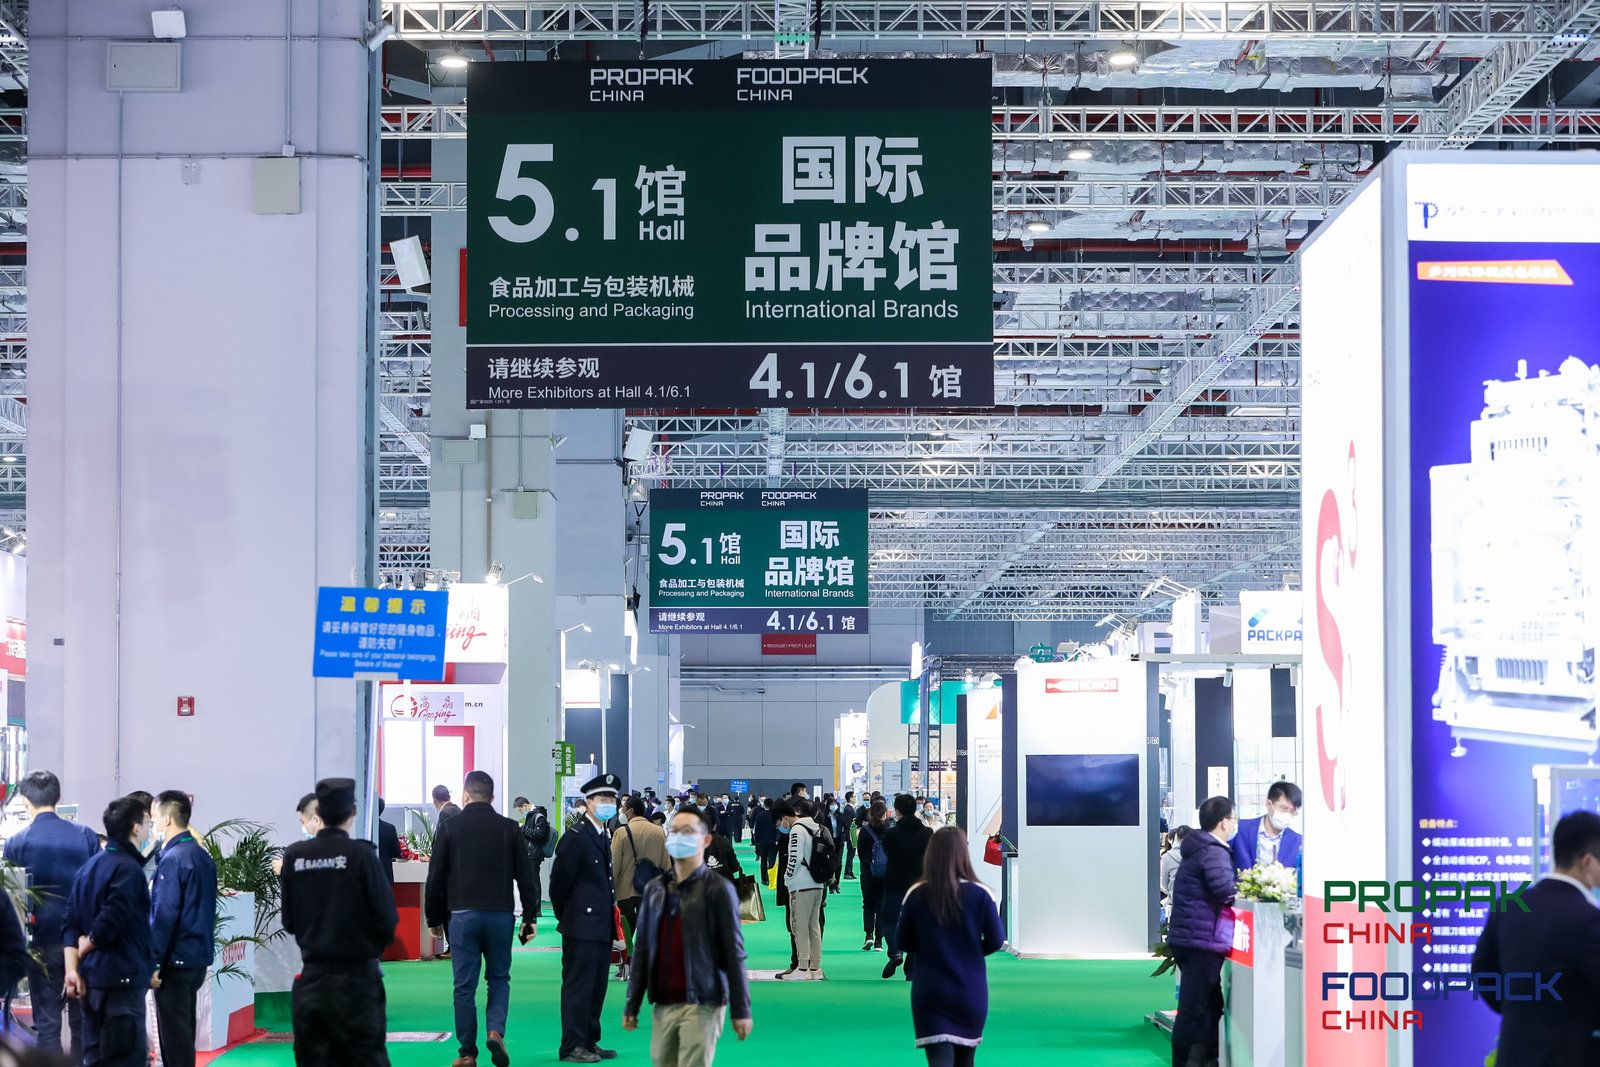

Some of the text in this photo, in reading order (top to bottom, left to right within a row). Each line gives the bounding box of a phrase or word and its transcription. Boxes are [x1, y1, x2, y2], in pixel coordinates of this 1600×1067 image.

[590, 67, 693, 86] PROPAK
[737, 67, 869, 85] FOODPACK
[590, 90, 644, 102] CHINA
[737, 89, 792, 101] CHINA
[782, 136, 924, 204] 国际
[488, 143, 686, 243] 5.1 馆
[639, 220, 685, 241] Hall
[745, 220, 959, 292] 品牌馆
[489, 275, 695, 299] 食品加工与包装机械
[489, 303, 694, 321] Processing and Packaging
[746, 300, 959, 319] International Brands
[488, 357, 600, 380] 请继续参观
[749, 353, 963, 399] 4.1/6.1 馆
[488, 385, 691, 399] More Exhibitors at Hall 4.1/6.1
[700, 491, 745, 500] PROPAK
[761, 491, 817, 500] FOODPACK
[658, 523, 741, 566] 5.1 馆
[780, 520, 840, 550] 国际
[720, 555, 741, 565] Hall
[765, 555, 855, 587] 品牌馆
[658, 579, 745, 589] 食品加工与包装机械
[765, 589, 855, 598] International Brands
[658, 590, 695, 598] Processing
[710, 590, 745, 598] Packaging
[658, 612, 706, 622] 请继续参观
[766, 611, 856, 631] 4.1/6.1 馆
[786, 832, 798, 877] HOLLISTER
